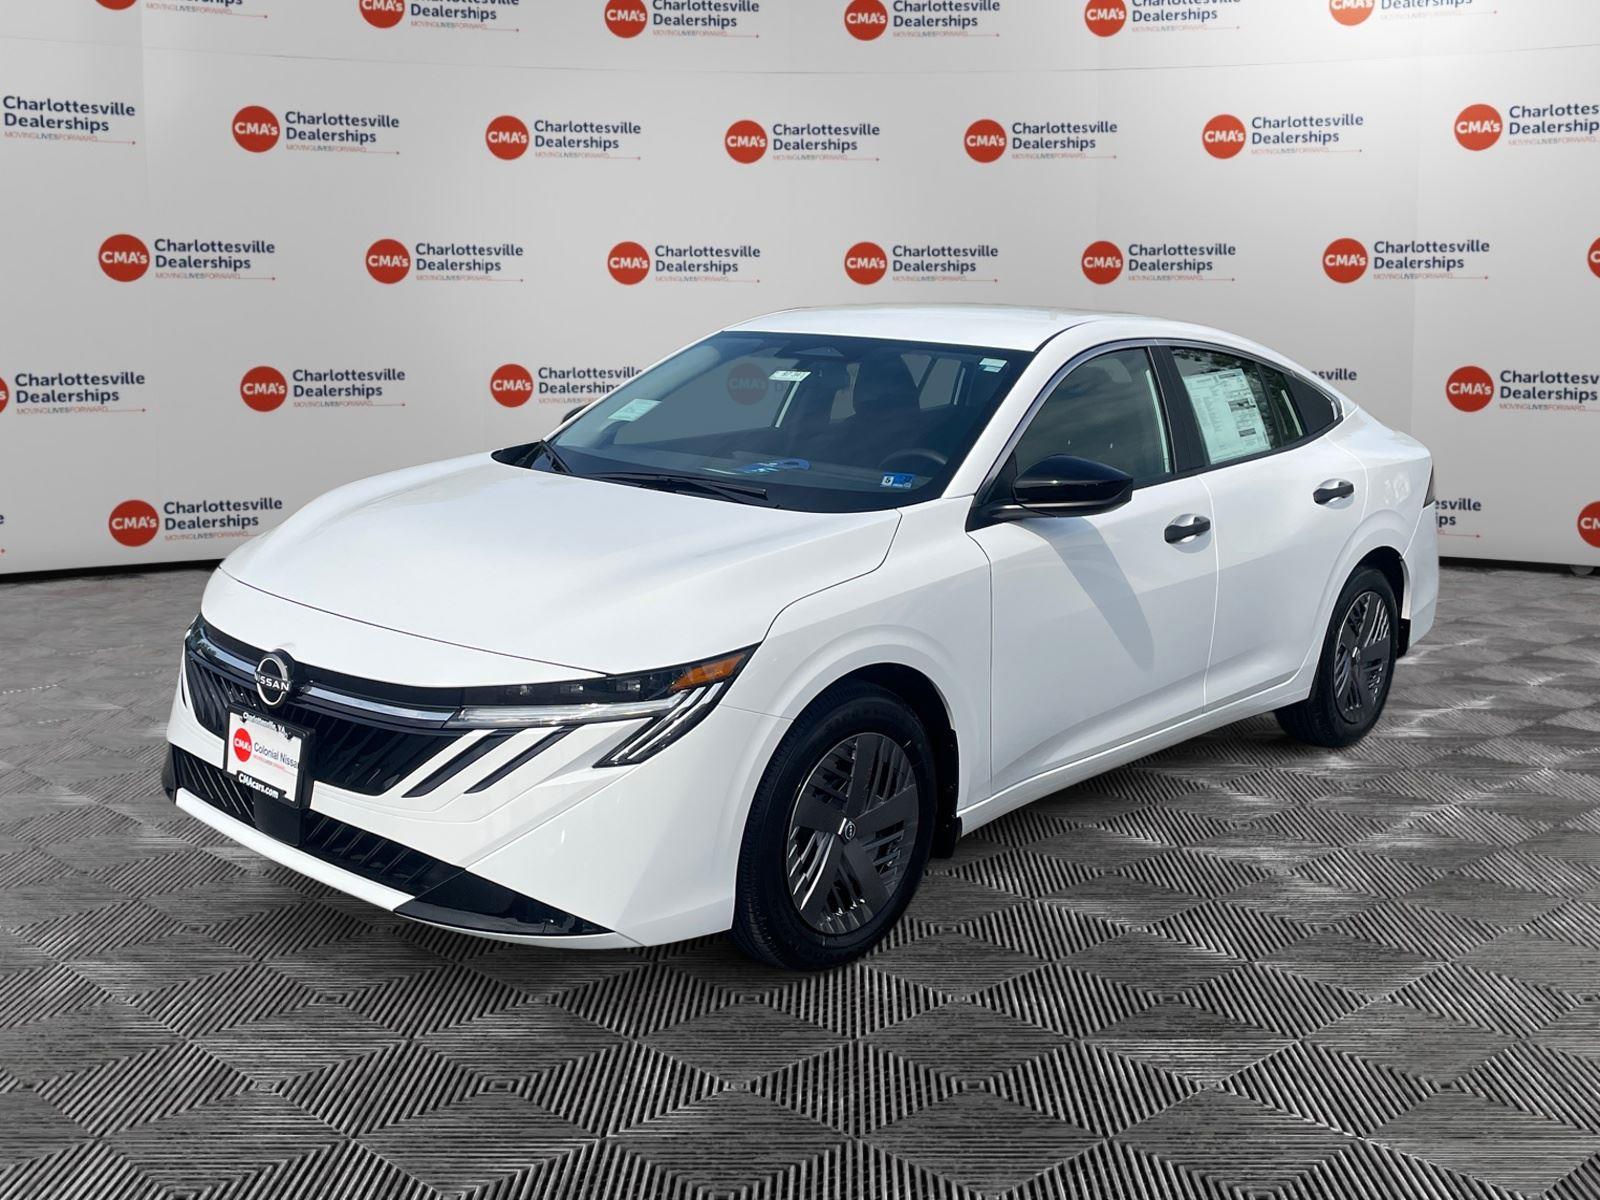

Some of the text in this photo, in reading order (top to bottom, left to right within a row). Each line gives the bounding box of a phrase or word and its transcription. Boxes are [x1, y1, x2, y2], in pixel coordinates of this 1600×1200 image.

[362, 0, 402, 11] CMA's
[653, 0, 759, 12] Charlottesville
[894, 0, 1000, 12] Charlottesville
[411, 4, 496, 22] Dealerships
[607, 9, 645, 21] CMA's
[847, 13, 886, 24] CMA's
[1087, 8, 1124, 20] CMA's
[1133, 8, 1217, 22] Dealerships
[654, 13, 737, 29] Dealerships
[894, 15, 978, 29] Dealerships
[3, 96, 135, 116] Charlottesville
[1509, 104, 1600, 118] Charlottes
[4, 113, 109, 134] Dealerships
[285, 111, 399, 128] Charlottesville
[1252, 114, 1363, 129] Charlottesville
[235, 122, 277, 135] CMA's
[534, 120, 641, 134] Charlottesville
[773, 124, 880, 135] Charlottesville
[1012, 121, 1117, 134] Charlottesville
[1456, 120, 1501, 134] CMA's
[1509, 119, 1600, 135] Dealership
[286, 127, 376, 145] Dealerships
[488, 132, 527, 143] CMA's
[727, 136, 765, 147] CMA's
[967, 135, 1005, 146] CMA's
[1205, 130, 1244, 142] CMA's
[1252, 131, 1339, 145] Dealerships
[535, 135, 619, 152] Dealerships
[773, 139, 857, 153] Dealerships
[1013, 137, 1095, 151] Dealerships
[154, 239, 275, 253] Charlottesville
[416, 243, 523, 256] Charlottesville
[655, 245, 760, 257] Charlottesville
[893, 245, 998, 257] Charlottesville
[1129, 244, 1236, 256] Charlottesville
[1374, 240, 1489, 253] Charlottesville
[102, 252, 147, 264] CMA's
[156, 255, 251, 272] Dealerships
[368, 255, 408, 267] CMA's
[610, 257, 648, 268] CMA's
[847, 258, 885, 268] CMA's
[1084, 257, 1121, 268] CMA's
[1325, 254, 1367, 267] CMA's
[1374, 256, 1464, 272] Dealerships
[417, 258, 501, 274] Dealerships
[656, 260, 738, 275] Dealerships
[893, 260, 976, 274] Dealerships
[1129, 259, 1212, 274] Dealerships
[15, 372, 145, 387] Charlottesville
[293, 368, 405, 382] Charlottesville
[1500, 370, 1600, 384] Charlottesv
[243, 383, 285, 395] CMA's
[294, 384, 382, 399] Dealerships
[493, 380, 531, 391] CMA's
[538, 382, 619, 394] Dealership
[1448, 382, 1492, 396] CMA's
[16, 389, 119, 405] Dealerships
[1500, 386, 1598, 404] Dealerships
[164, 497, 282, 514] Charlottesville
[112, 517, 156, 529] CMA's
[165, 514, 259, 530] Dealerships
[254, 671, 289, 691] NISSAN
[253, 742, 280, 760] Colonial
[279, 752, 298, 769] Nissa
[239, 774, 279, 799] CMAcars.com
